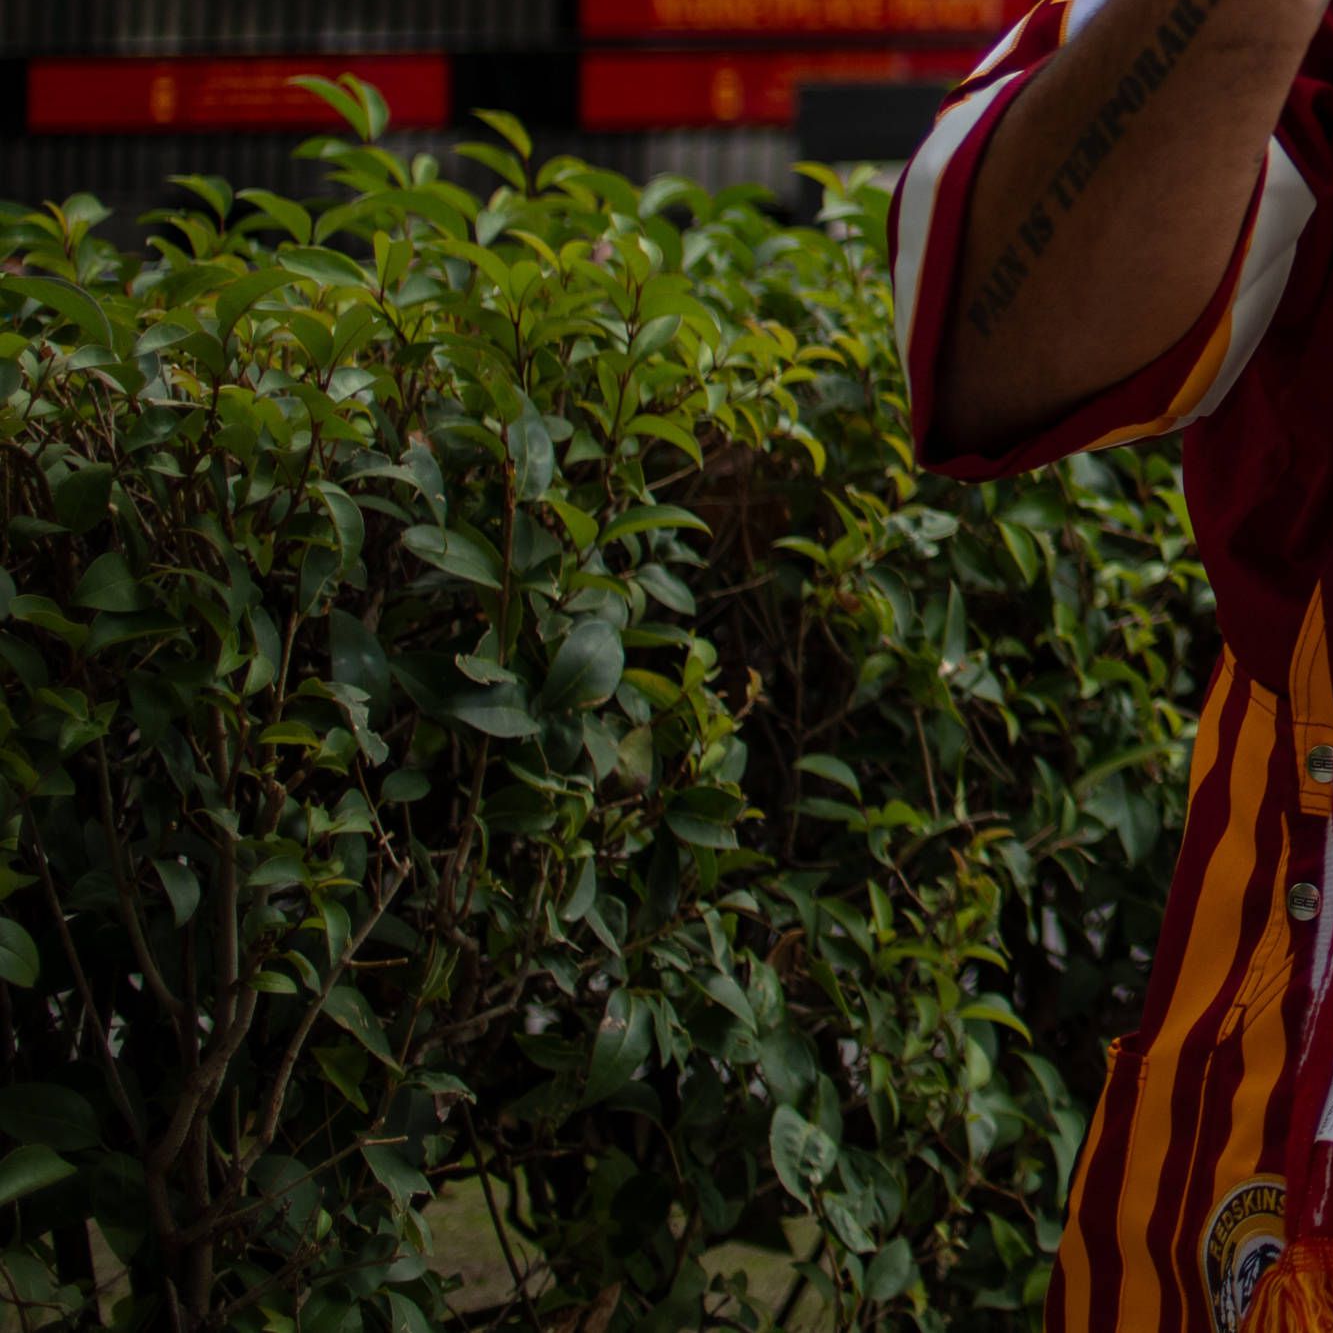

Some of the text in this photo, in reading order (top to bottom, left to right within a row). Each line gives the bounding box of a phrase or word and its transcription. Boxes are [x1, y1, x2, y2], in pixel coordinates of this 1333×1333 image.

[967, 244, 1029, 338] PAIN
[1016, 202, 1055, 258] IS
[1209, 1187, 1287, 1261] REDSKINS
